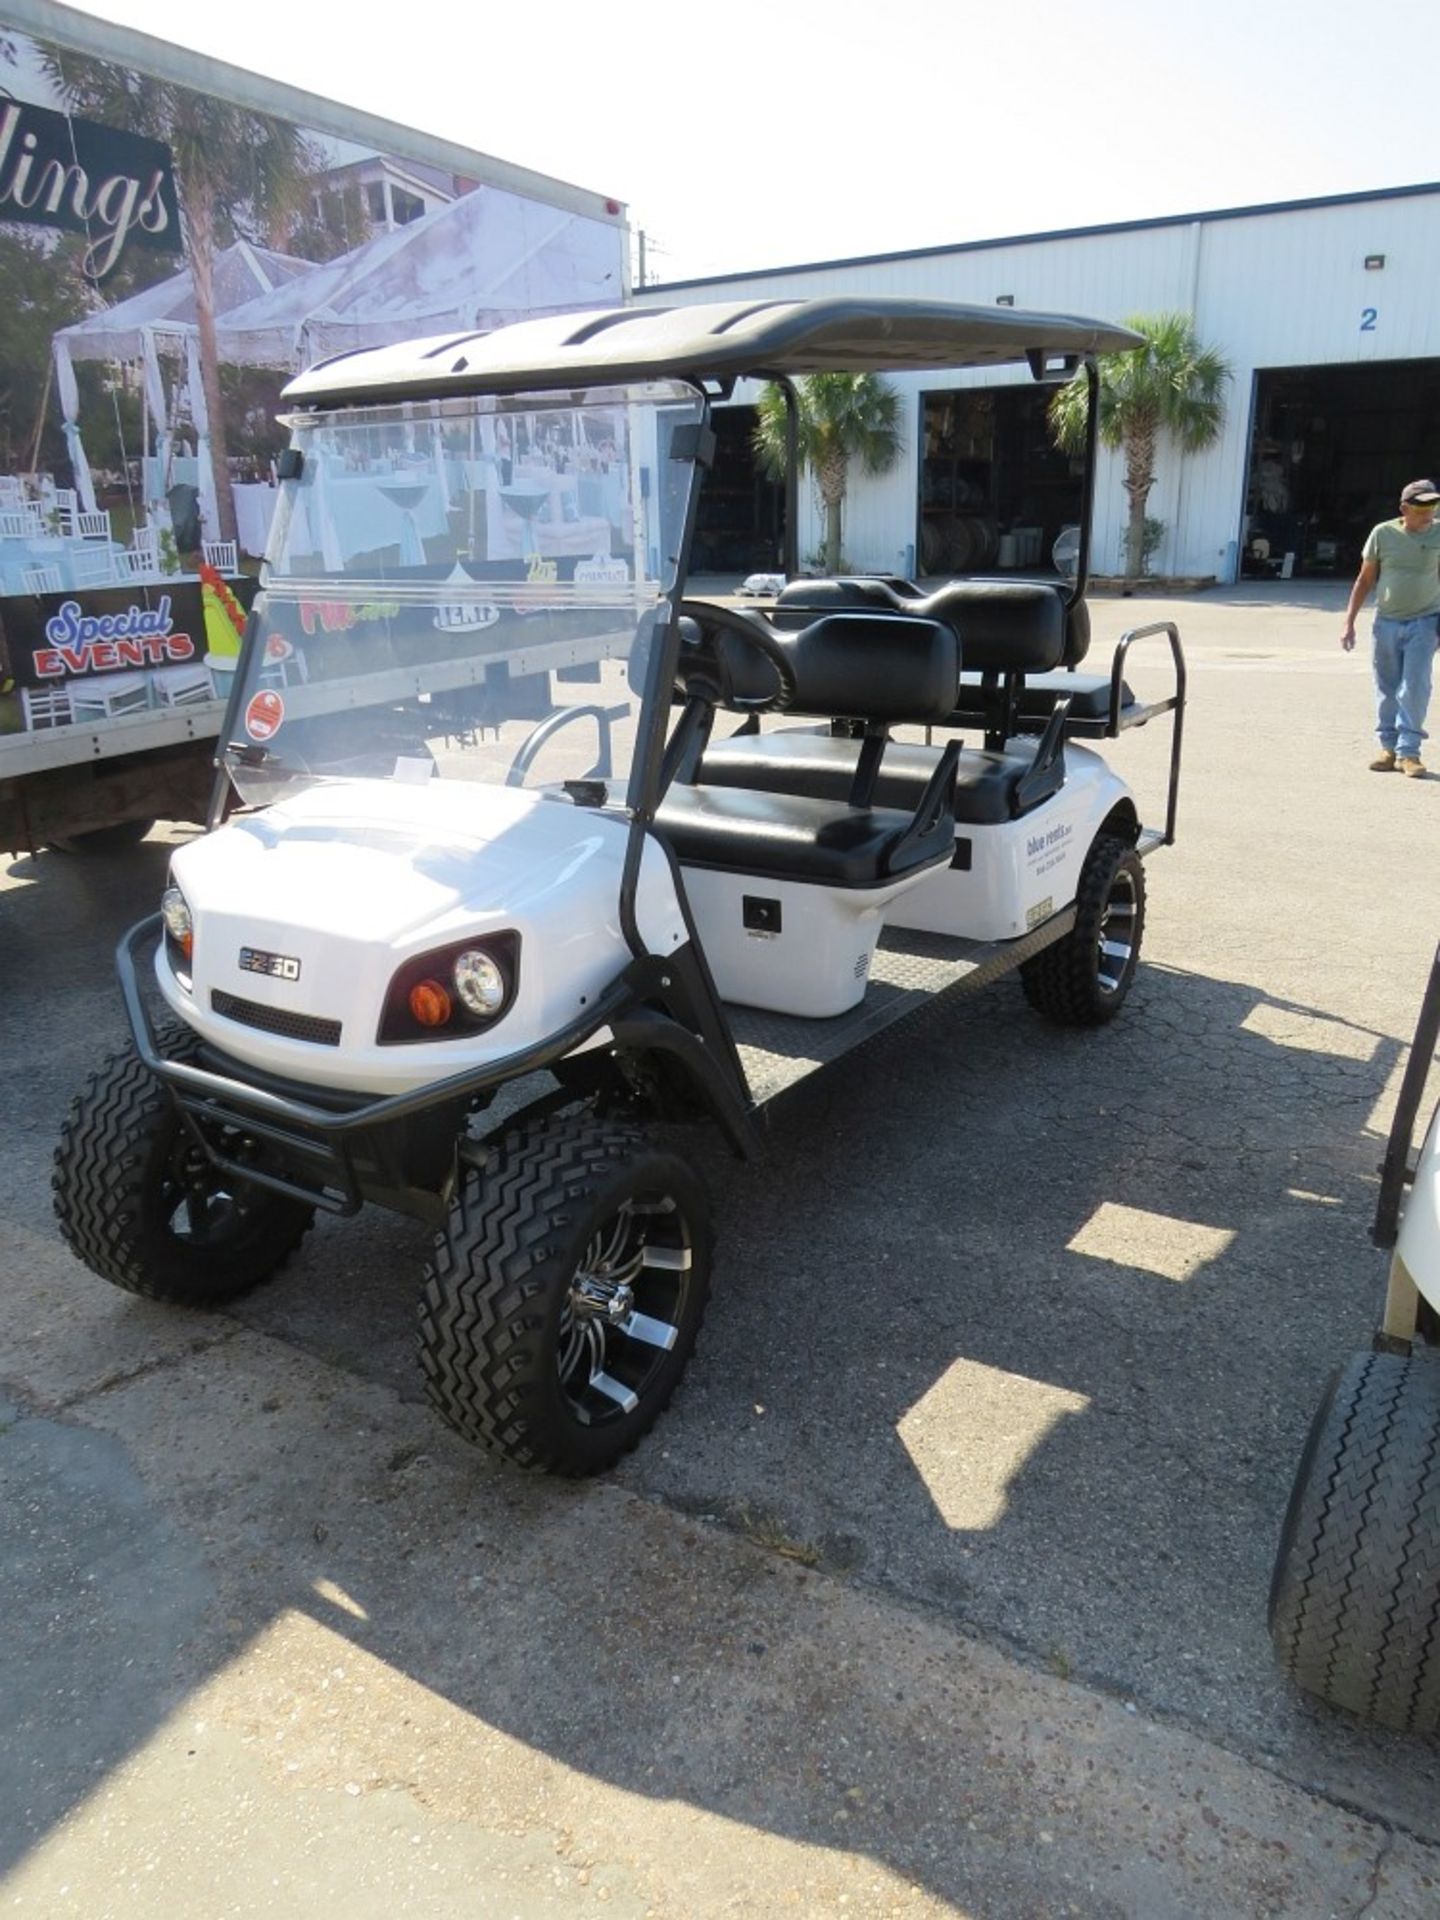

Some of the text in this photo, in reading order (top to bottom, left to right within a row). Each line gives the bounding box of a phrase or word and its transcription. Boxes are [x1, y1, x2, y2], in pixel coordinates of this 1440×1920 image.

[1360, 307, 1377, 331] 2
[46, 595, 173, 655] Special
[33, 633, 194, 679] EVENTS
